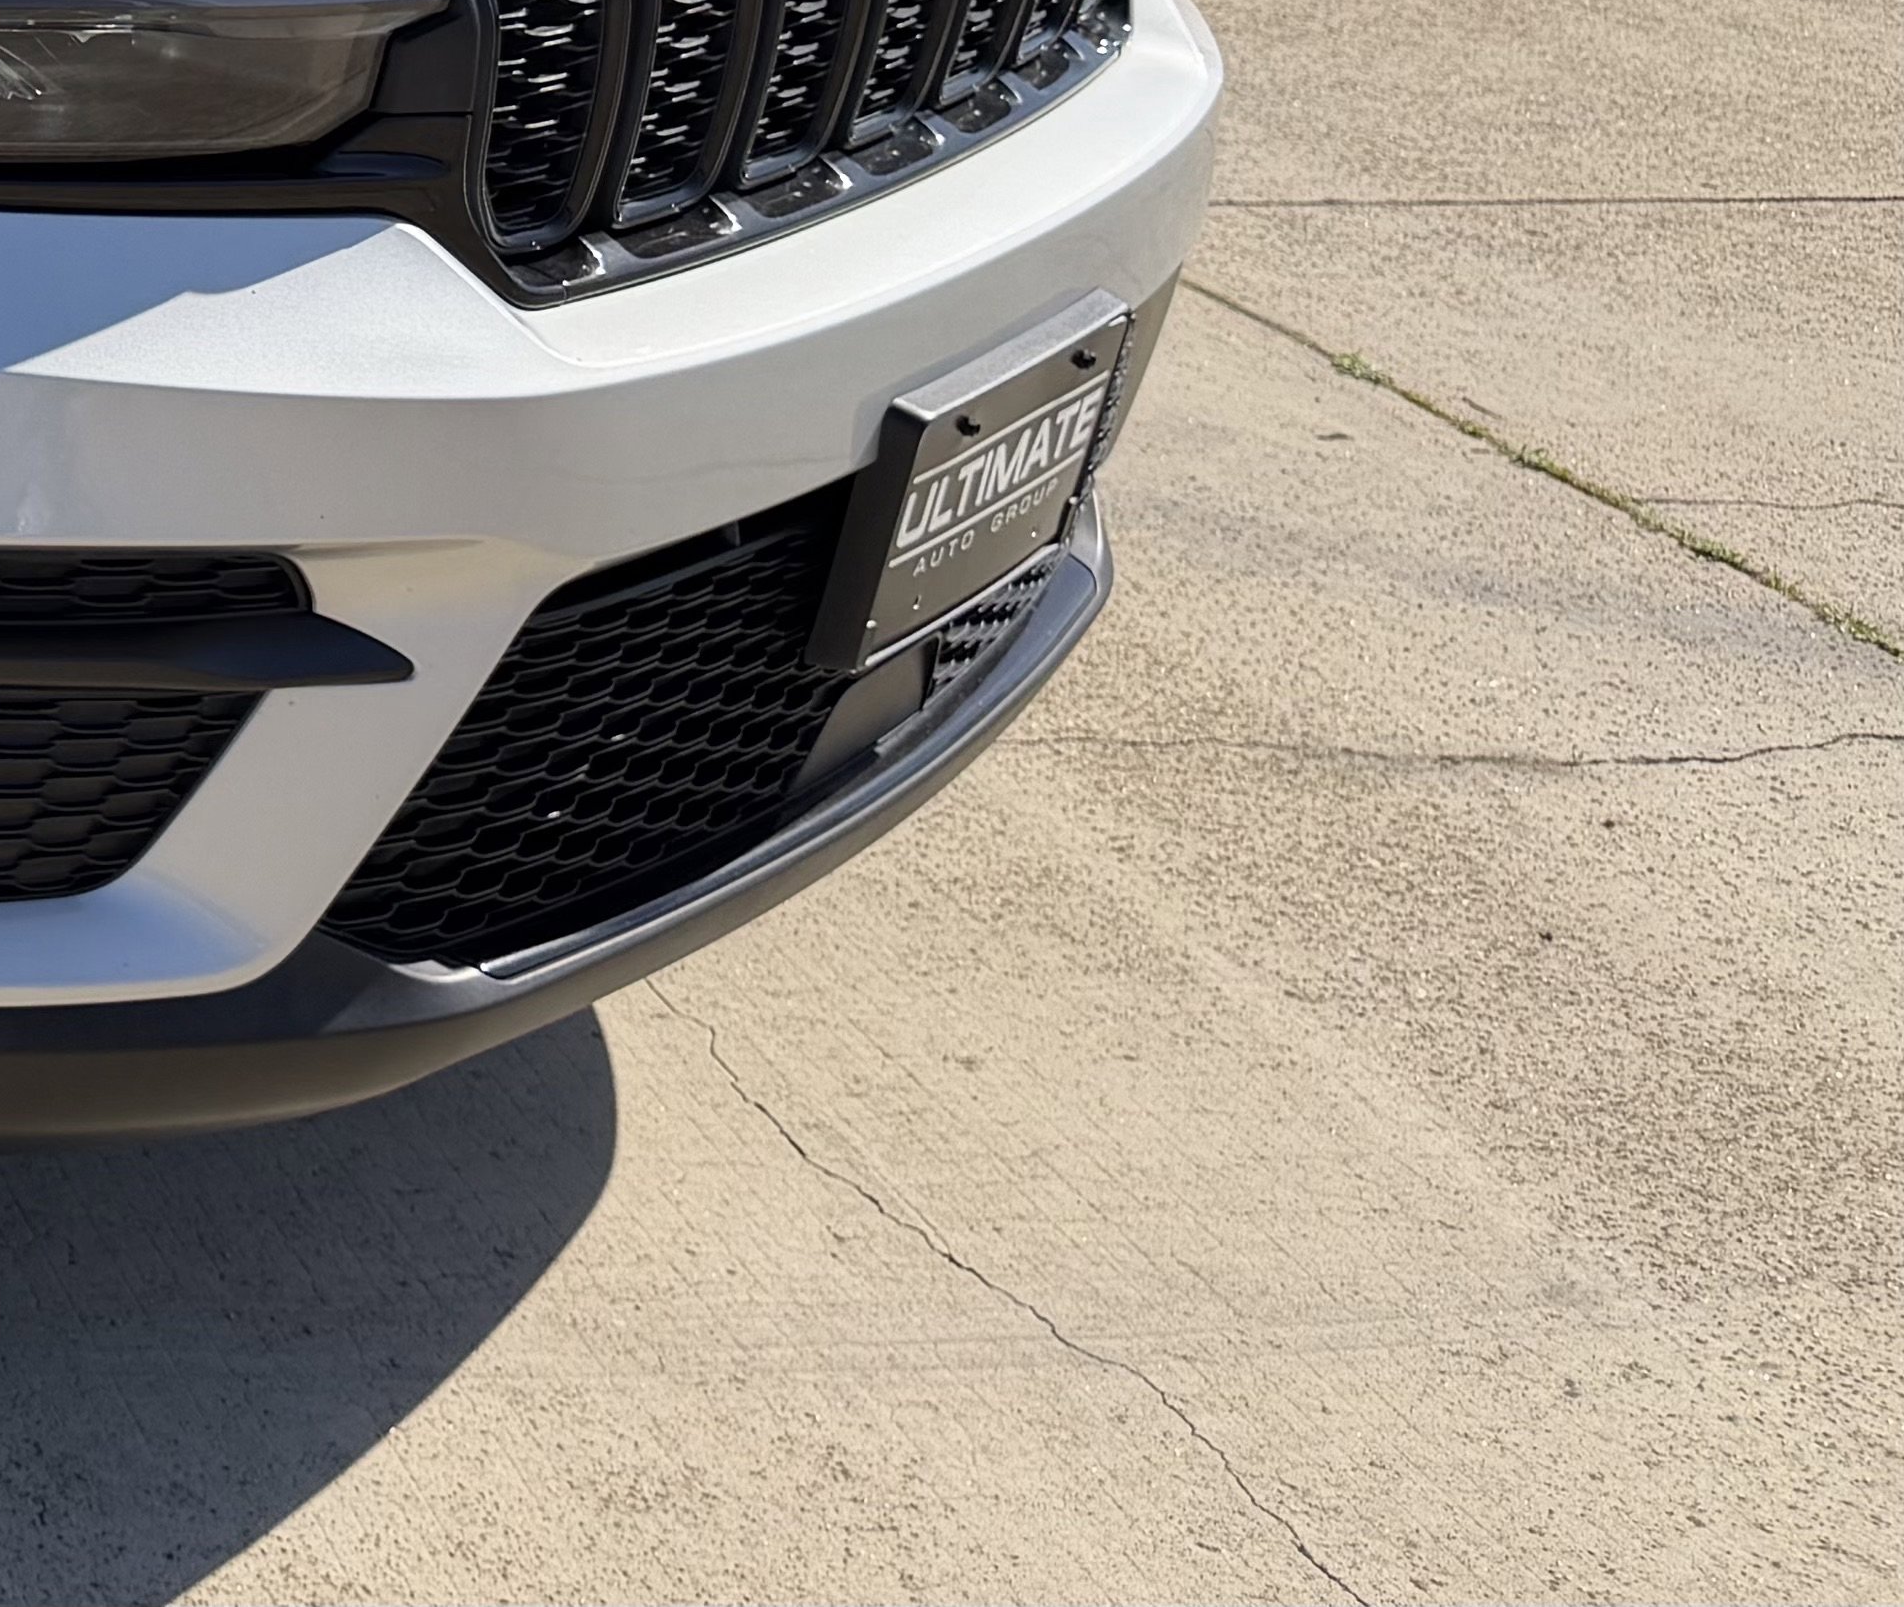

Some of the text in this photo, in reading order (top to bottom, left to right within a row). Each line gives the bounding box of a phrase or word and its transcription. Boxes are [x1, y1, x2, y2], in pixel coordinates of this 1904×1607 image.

[895, 386, 1106, 549] ULTIMATE
[912, 477, 1060, 577] AUTO GROUP
